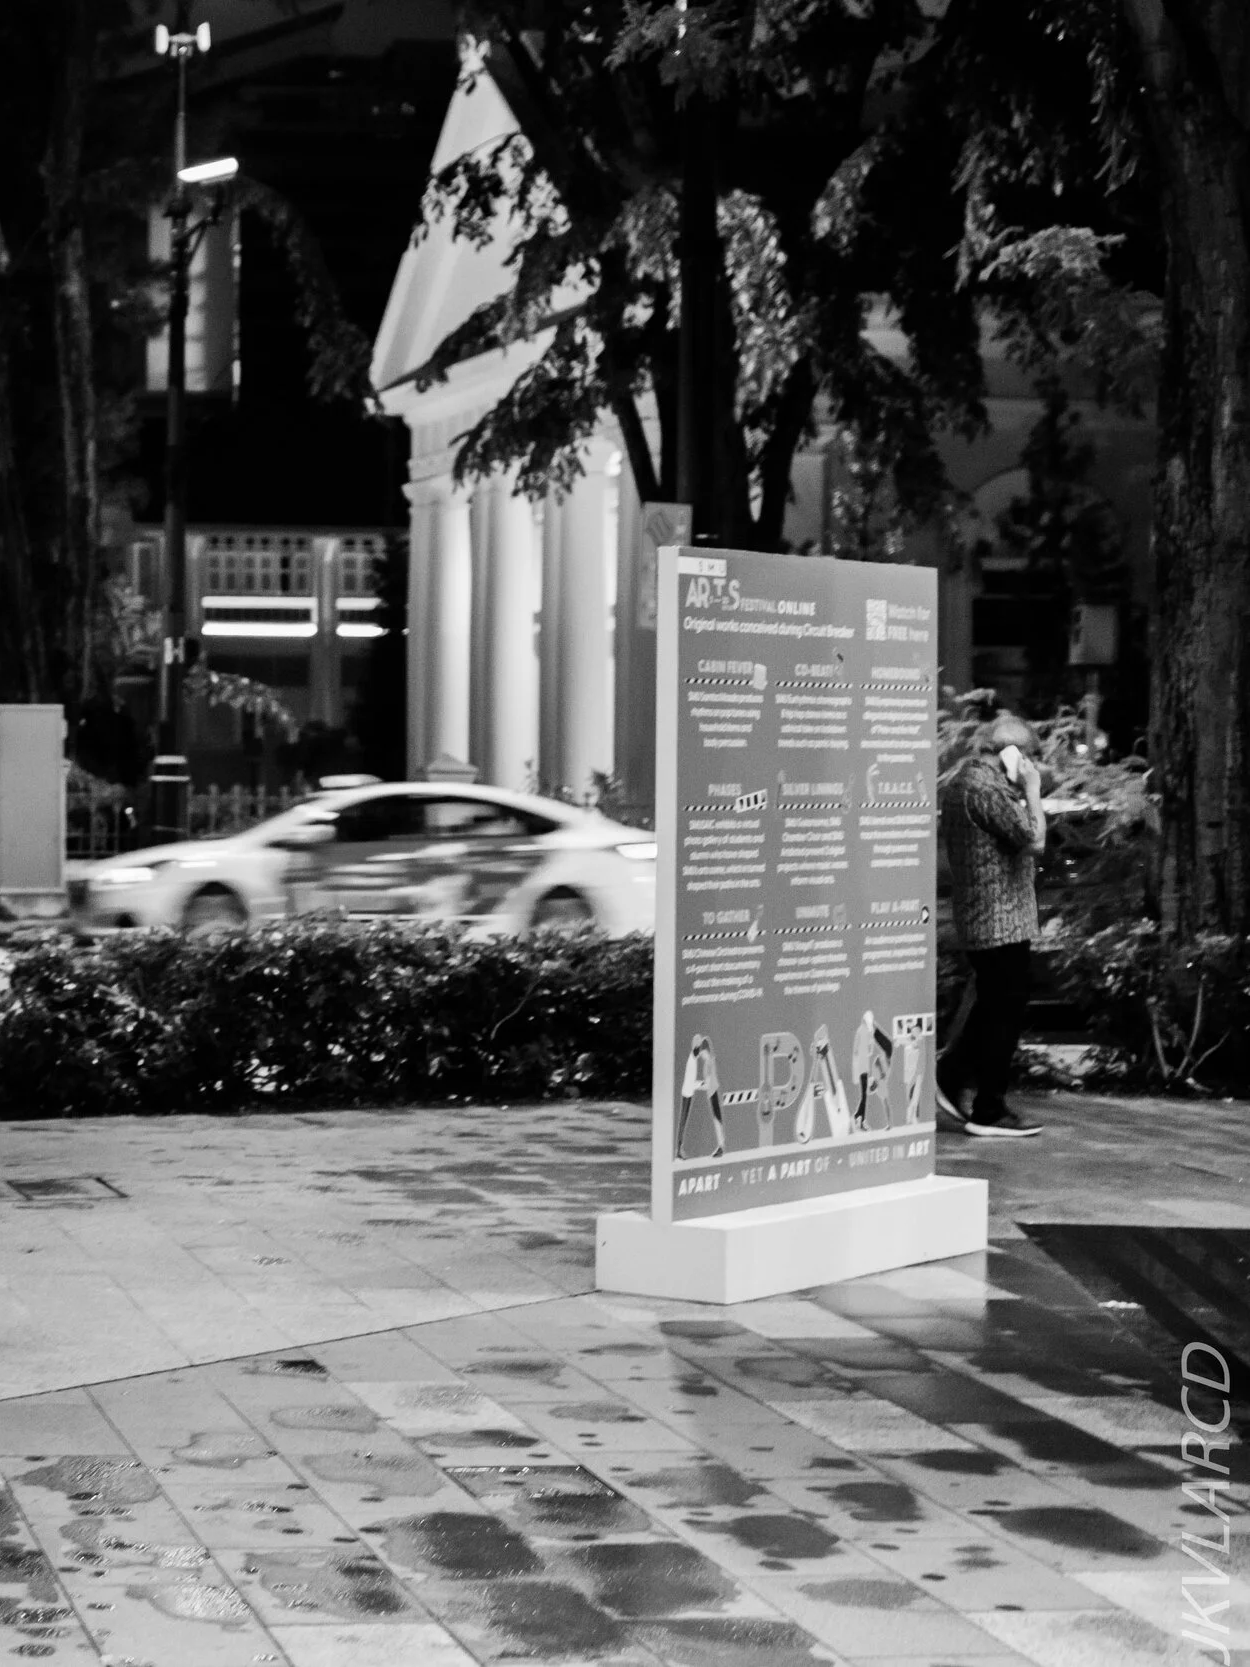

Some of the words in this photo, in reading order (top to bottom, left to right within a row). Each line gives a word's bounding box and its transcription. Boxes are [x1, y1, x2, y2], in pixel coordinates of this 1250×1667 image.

[777, 600, 817, 616] ONLINE
[683, 616, 716, 634] Original
[716, 618, 740, 633] works
[677, 1173, 721, 1196] APART
[741, 1166, 764, 1186] YET
[766, 1164, 778, 1182] A
[780, 1159, 811, 1180] PART
[814, 1156, 831, 1173] OF
[849, 1146, 890, 1168] UNITED
[907, 1139, 931, 1158] ART
